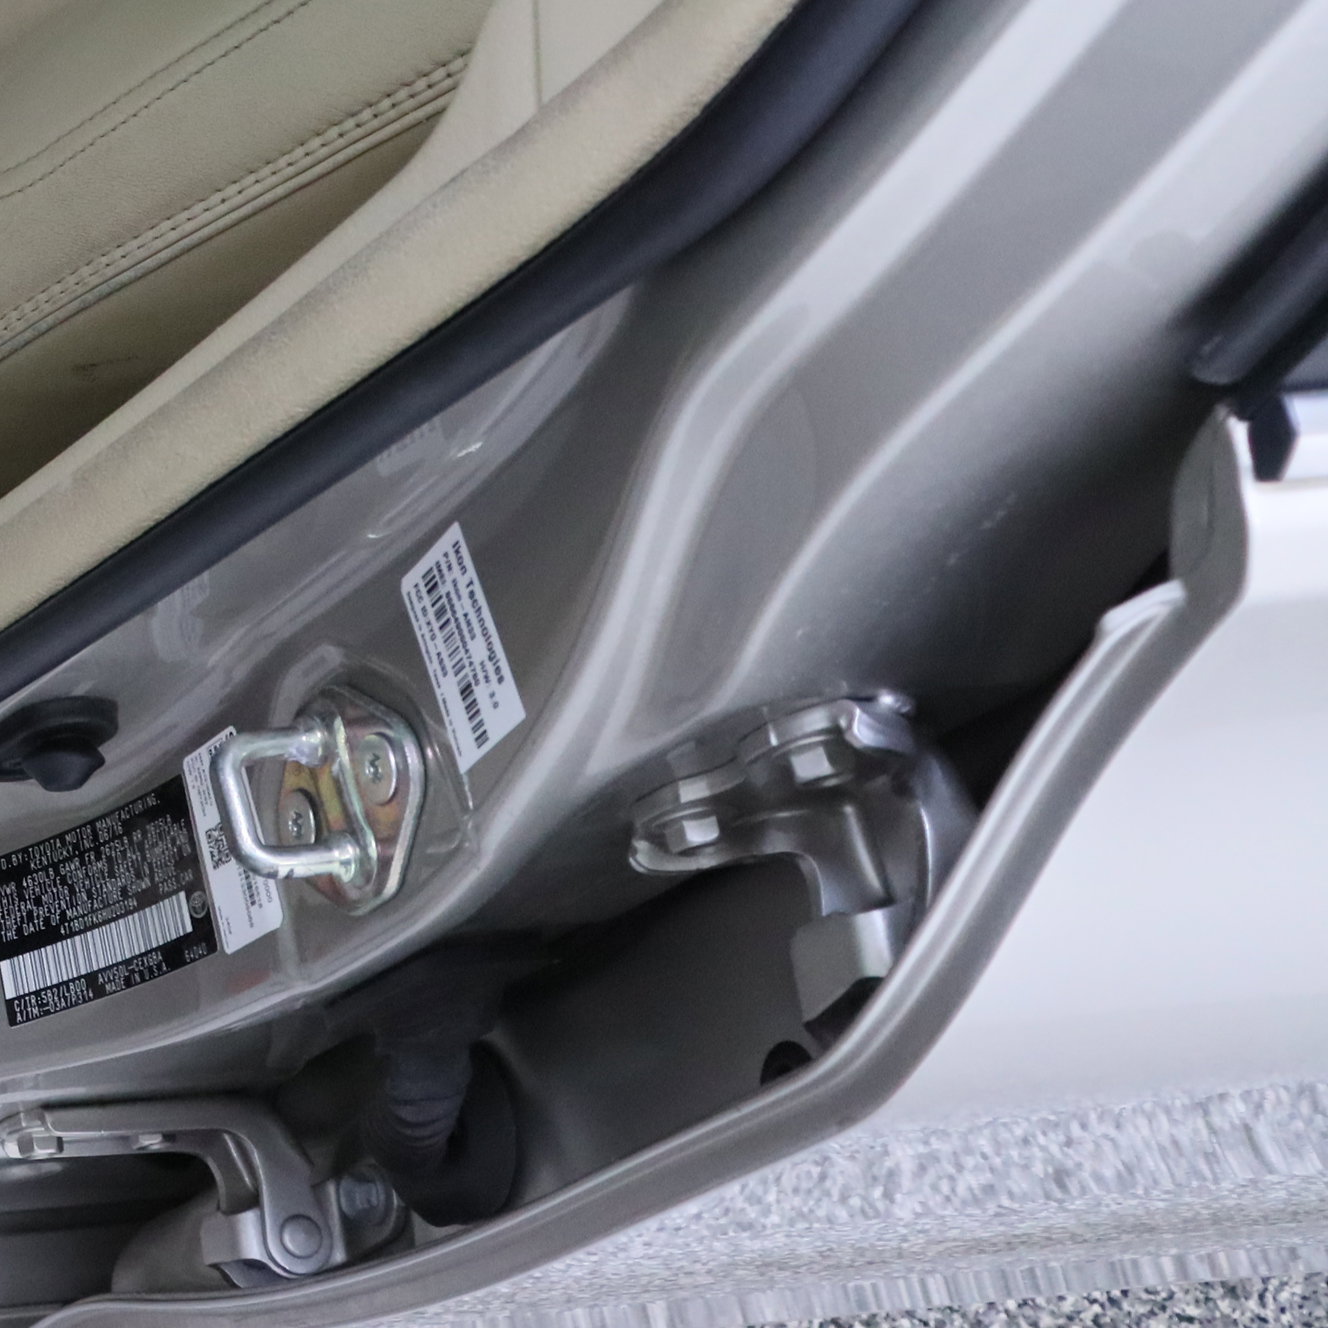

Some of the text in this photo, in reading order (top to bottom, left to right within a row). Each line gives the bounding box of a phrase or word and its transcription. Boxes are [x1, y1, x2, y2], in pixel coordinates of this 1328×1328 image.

[450, 538, 469, 577] Ikon
[461, 577, 508, 687] Technologies
[64, 823, 91, 845] MOTOR
[21, 866, 55, 891] 4630LB
[58, 856, 81, 875] GAWR
[84, 850, 96, 864] FR
[23, 875, 62, 901] VEHICLE
[66, 857, 108, 885] CONFORMS
[41, 884, 70, 906] MOTOR
[74, 869, 109, 893] VEHICLE
[0, 911, 27, 933] THEFT
[32, 888, 87, 922] PREVENTION
[91, 870, 136, 898] STANDARDS
[1, 887, 122, 943] THE DATE OF MANUFACTURE
[104, 976, 125, 993] MADE
